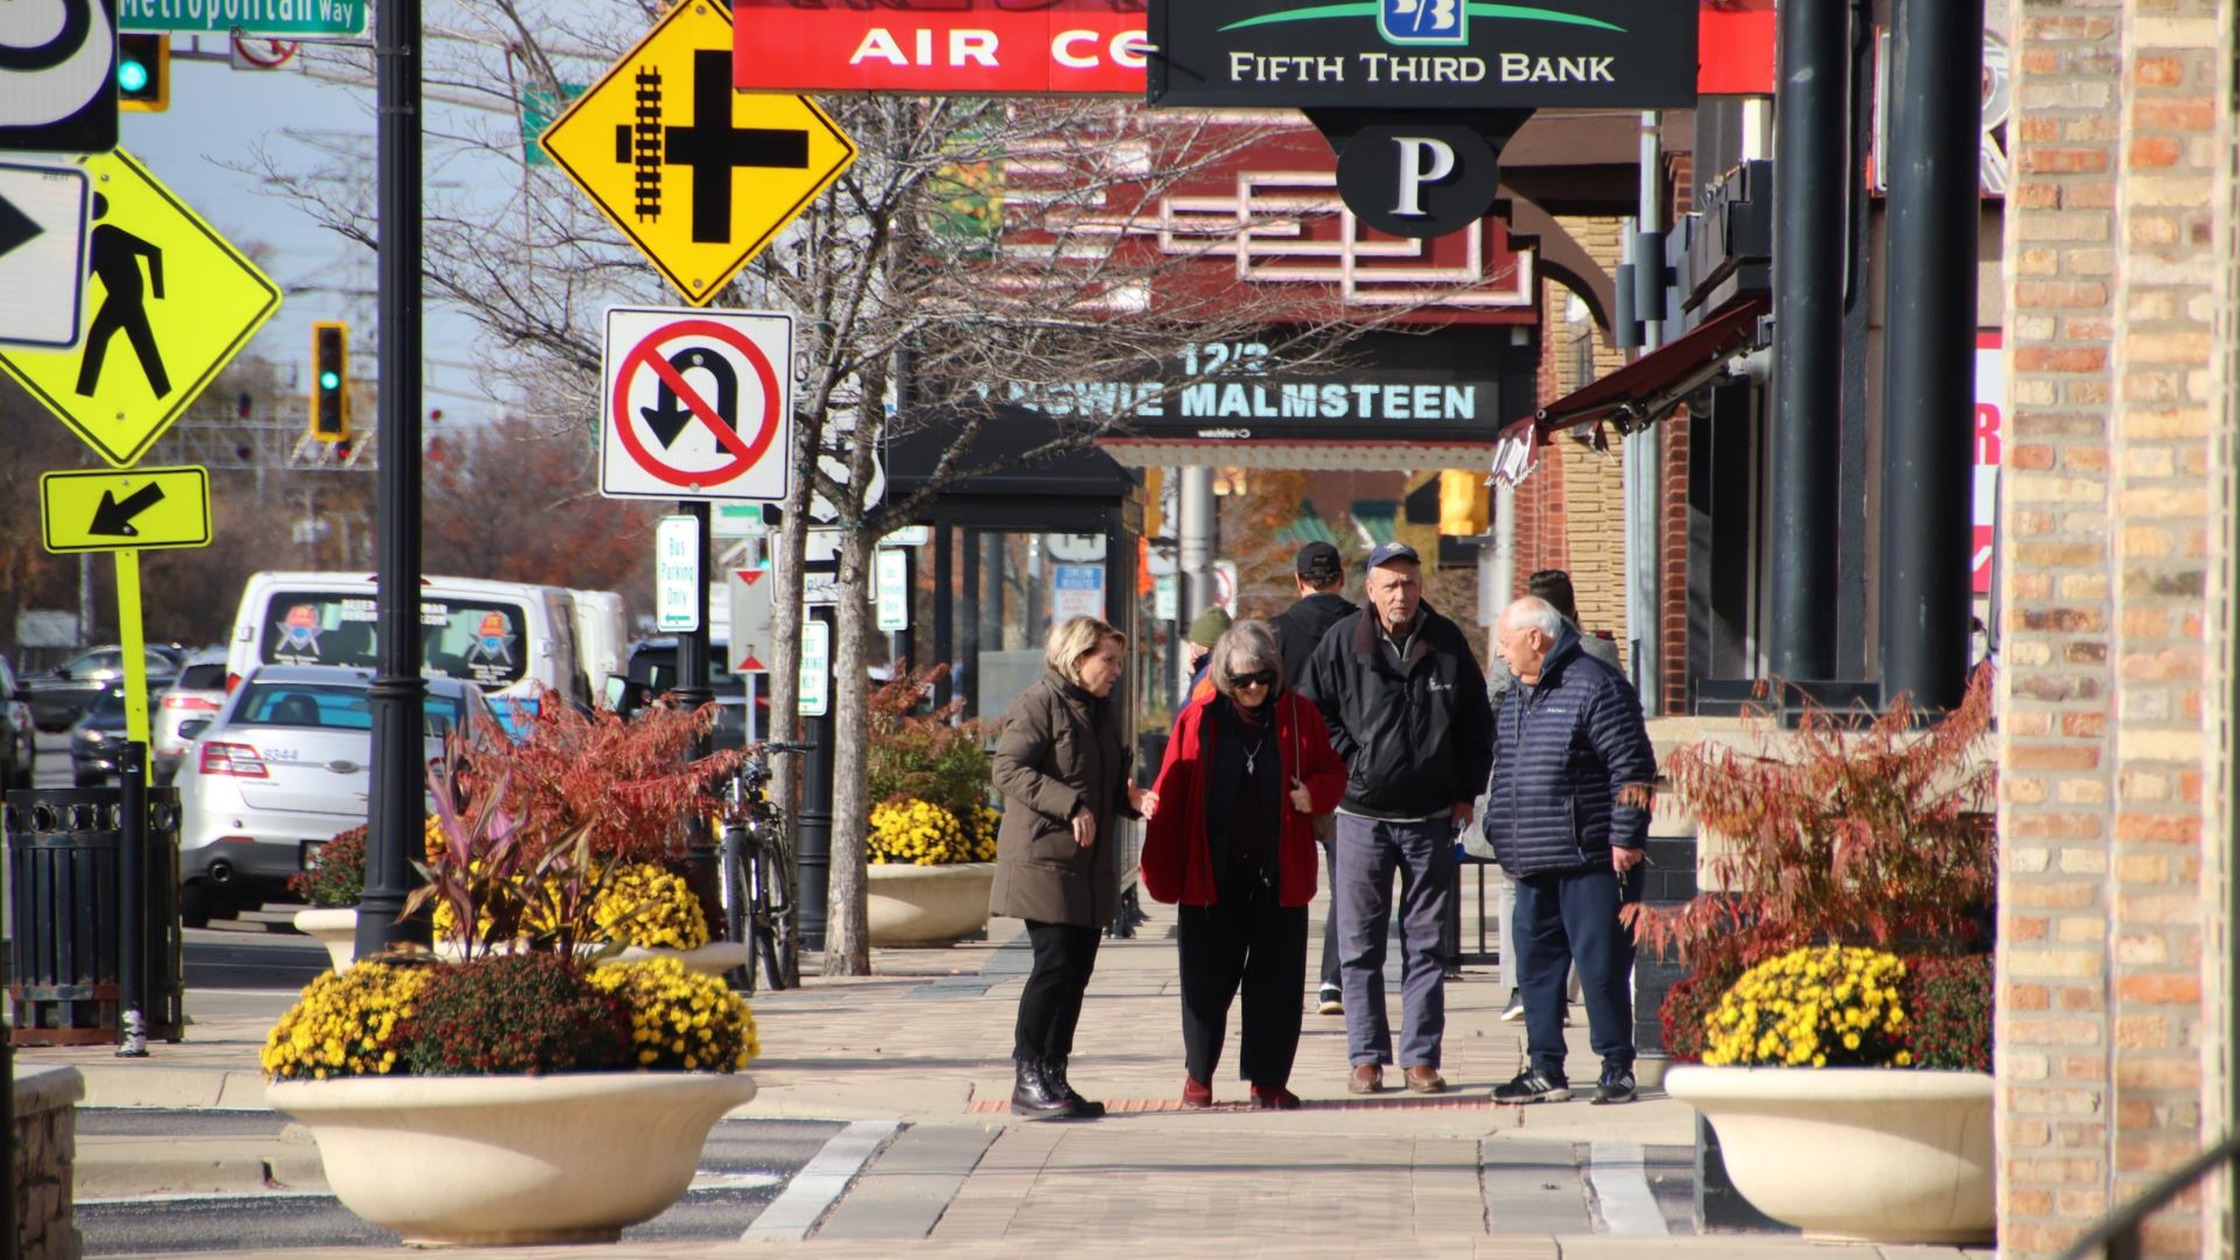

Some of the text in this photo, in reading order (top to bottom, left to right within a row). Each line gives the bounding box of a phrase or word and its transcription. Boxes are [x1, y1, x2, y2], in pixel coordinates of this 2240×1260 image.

[319, 0, 353, 28] Way
[849, 28, 1000, 66] AIR
[1228, 52, 1616, 83] FIFTH THIRD BANK
[1388, 136, 1455, 216] P
[1181, 383, 1476, 420] MALMSTEEN
[668, 537, 686, 556] Bus
[661, 562, 694, 584] Parking
[667, 588, 688, 606] Only
